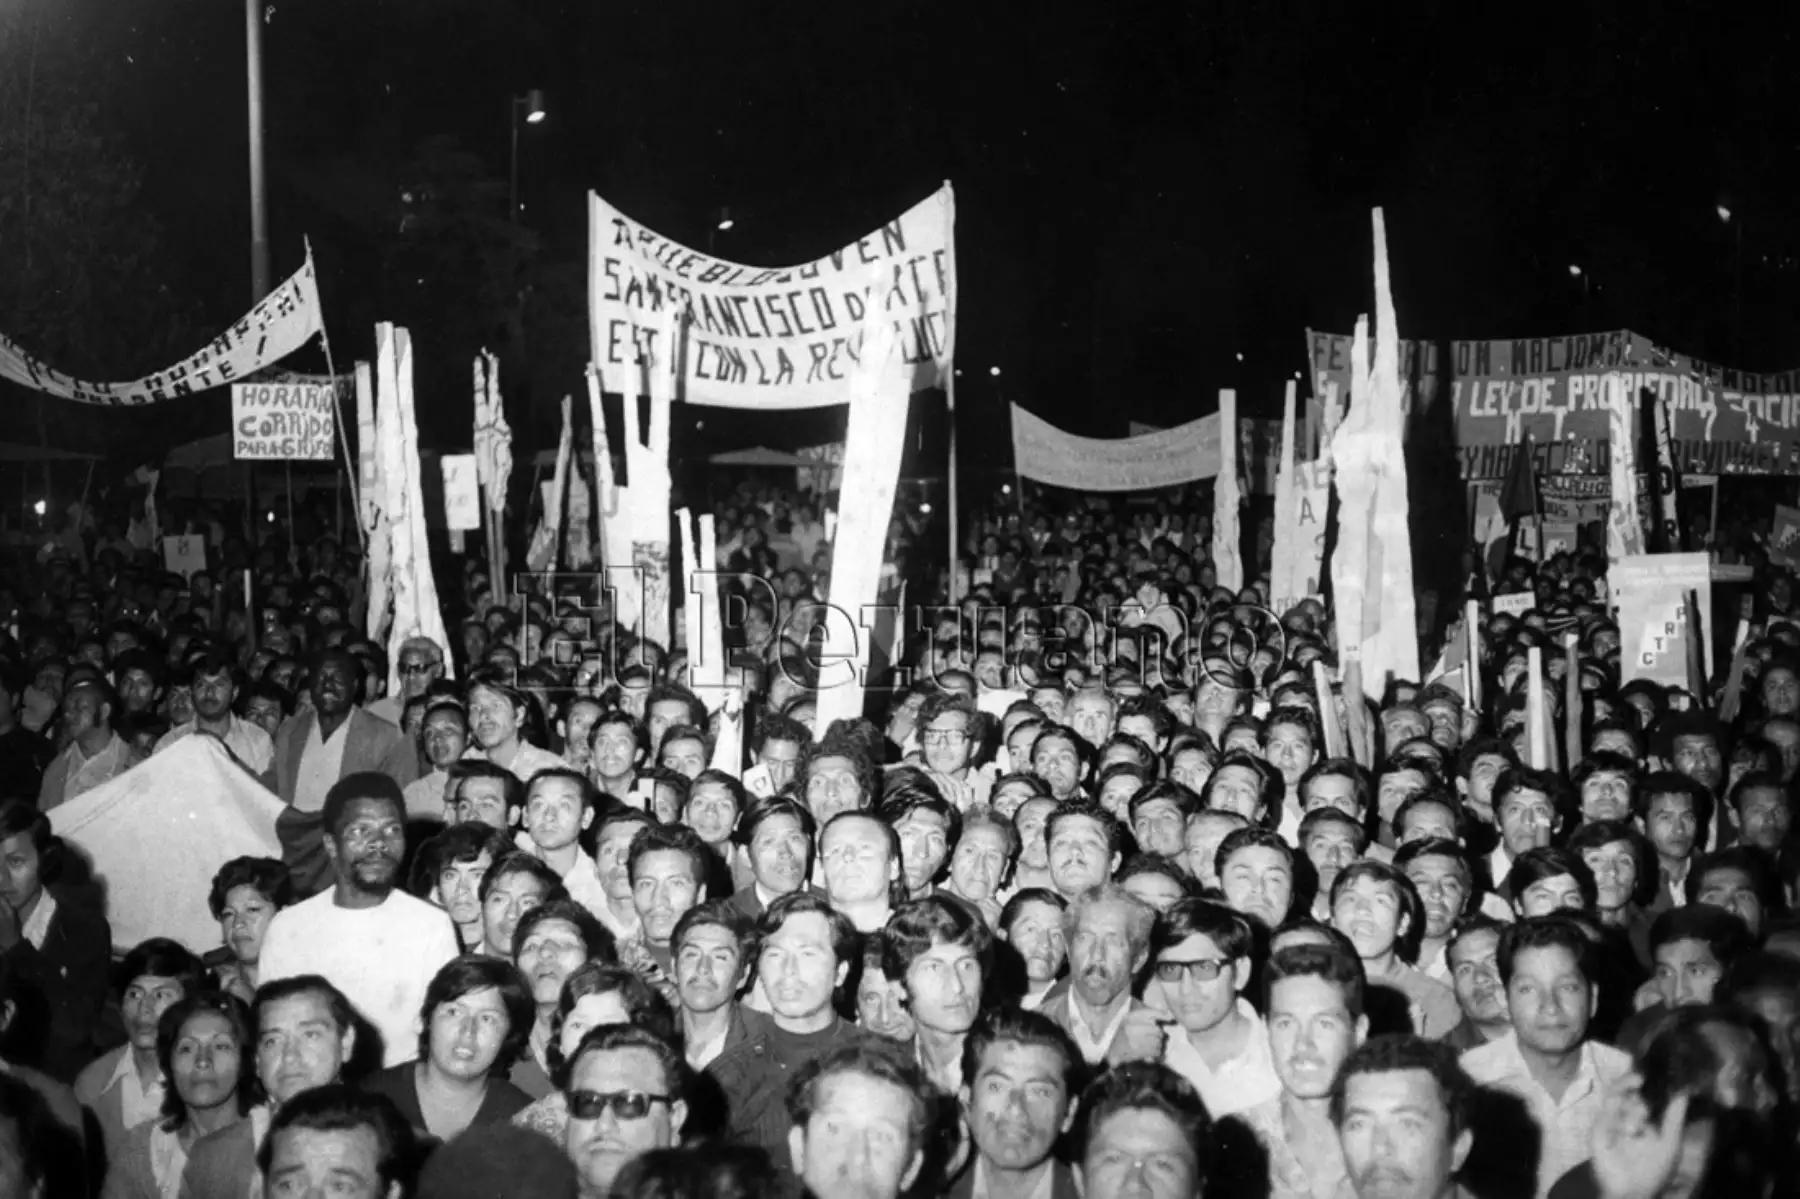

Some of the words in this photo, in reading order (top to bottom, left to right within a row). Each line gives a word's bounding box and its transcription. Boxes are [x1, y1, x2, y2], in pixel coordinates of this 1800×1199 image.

[696, 340, 747, 384] CON
[751, 346, 795, 386] LA
[241, 384, 333, 414] HORARIO
[1520, 377, 1557, 415] DE
